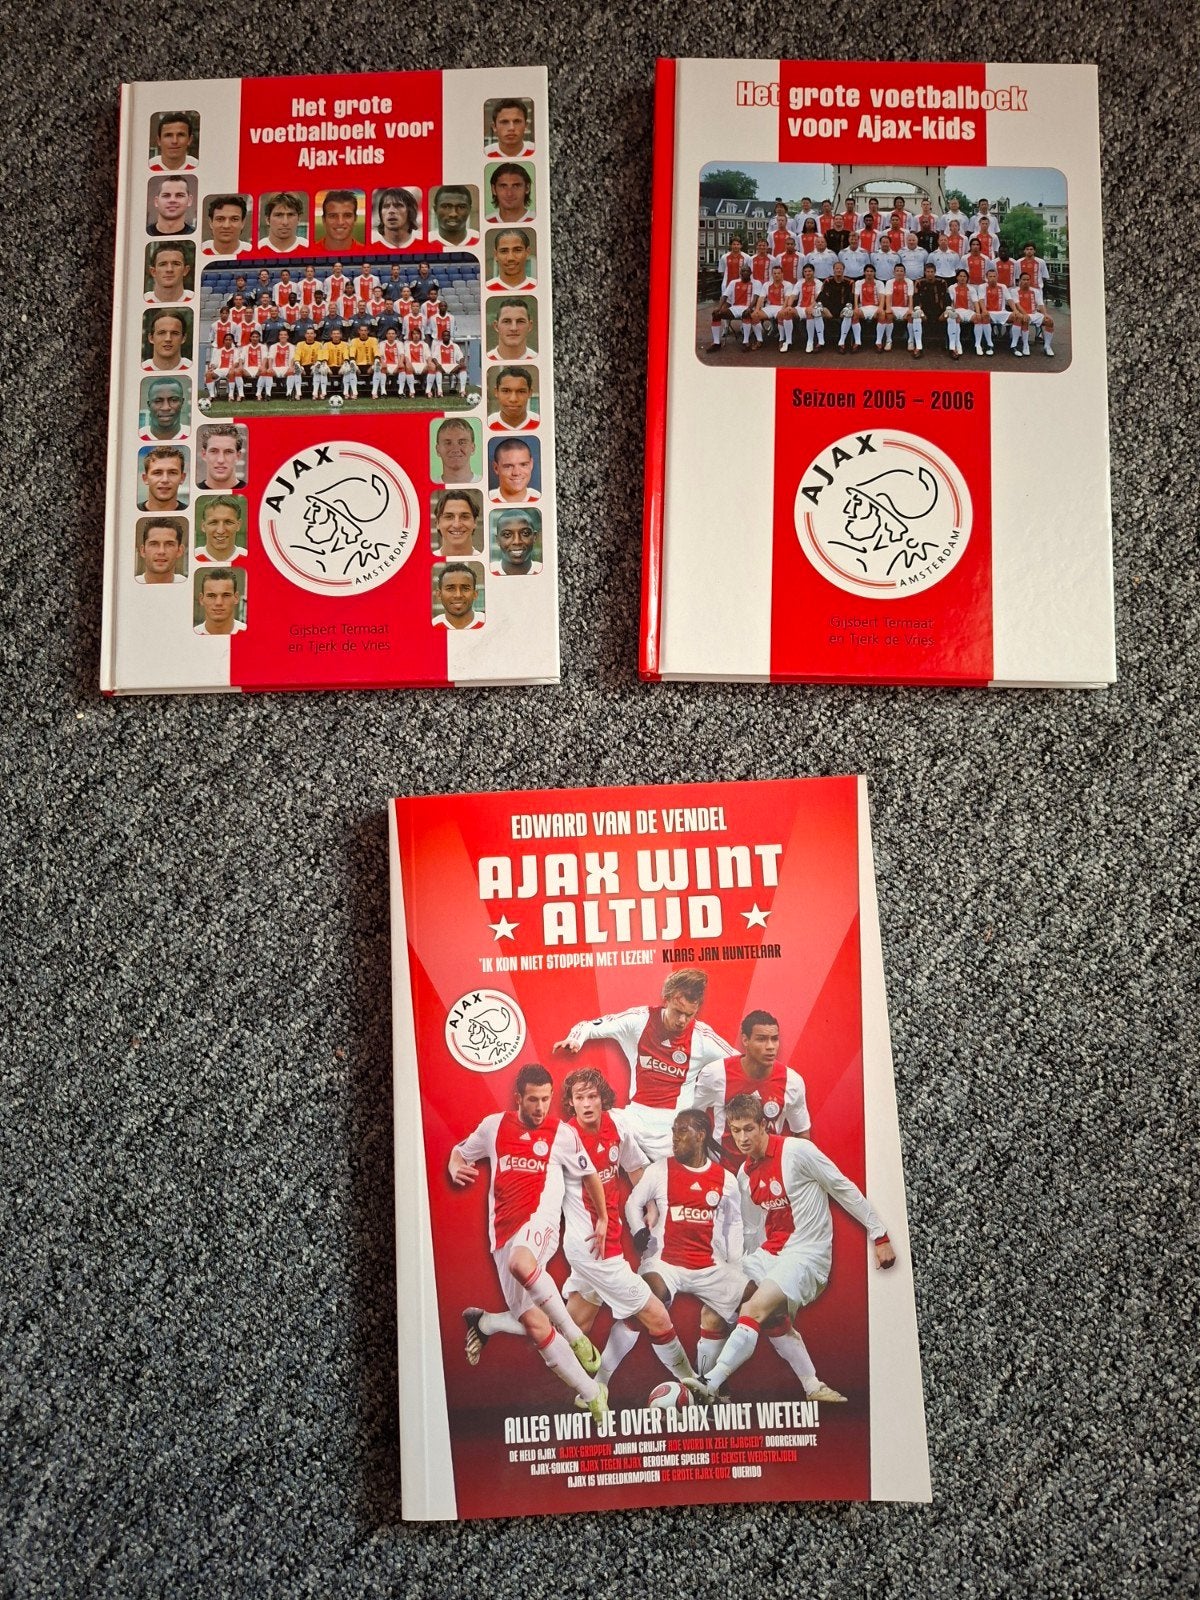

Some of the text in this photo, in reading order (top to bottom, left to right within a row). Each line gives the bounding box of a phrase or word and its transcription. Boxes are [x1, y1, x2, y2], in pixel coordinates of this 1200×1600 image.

[292, 96, 393, 118] Het grote
[737, 81, 1027, 111] Het grote voetbalboek
[250, 120, 434, 144] voetbalboek voor
[788, 115, 976, 142] voor Ajax-kids
[298, 145, 385, 170] Ajax-kids
[792, 388, 856, 408] Seizoen
[863, 390, 906, 410] 2005
[931, 391, 974, 411] 2006
[265, 446, 334, 514] AJAX
[801, 434, 877, 506] AJAX
[355, 530, 410, 585] AMSTERDAM
[899, 529, 961, 588] AMSTERDAM
[289, 623, 390, 638] Gijsbert Termaat
[885, 617, 935, 629] Termaat
[288, 639, 391, 655] en Tjerk de Vries
[829, 634, 844, 645] en
[884, 634, 900, 646] de
[905, 634, 935, 646] Vries
[511, 806, 728, 840] EDWARD VAN DE VENDEL
[478, 844, 783, 900] AJAX WINT
[542, 895, 723, 946] ALTIJD
[496, 957, 518, 972] KON
[520, 955, 544, 971] NIET
[546, 952, 594, 969] STOPPEN
[596, 951, 619, 967] MET
[662, 947, 695, 963] KLAAS
[698, 946, 720, 961] JAN
[722, 943, 782, 961] HUNTELAAR
[449, 993, 482, 1029] AJAX
[493, 1035, 521, 1066] AMSTERDAM
[640, 1055, 687, 1077] AEGON
[500, 1154, 546, 1172] AEGON
[525, 1229, 543, 1247] 10
[504, 1400, 820, 1444] ALLES WAT JE OVER AJAX WILT WETEN!
[509, 1450, 518, 1463] DE
[519, 1449, 537, 1461] HELD
[537, 1447, 556, 1460] AJAX
[559, 1443, 612, 1459] AJAX-GRAPPEN
[613, 1441, 638, 1455] JOHAN
[638, 1440, 667, 1453] CRUIJFF
[668, 1439, 682, 1451] HOE
[682, 1438, 705, 1450] WORD
[706, 1437, 713, 1449] IK
[714, 1436, 729, 1448] ZELF
[765, 1434, 818, 1448] DOORGEKNIPTE
[530, 1449, 798, 1476] AJAX-SOKKEN AJAX TEGEN AJAX BEROEMDE SPELERS DE GEKSTE WEDSTRIJDEN
[567, 1465, 762, 1488] AJAX IS WERELDKAMPIOEN DE GROTE AJAX-QUIZ QUERIDO
